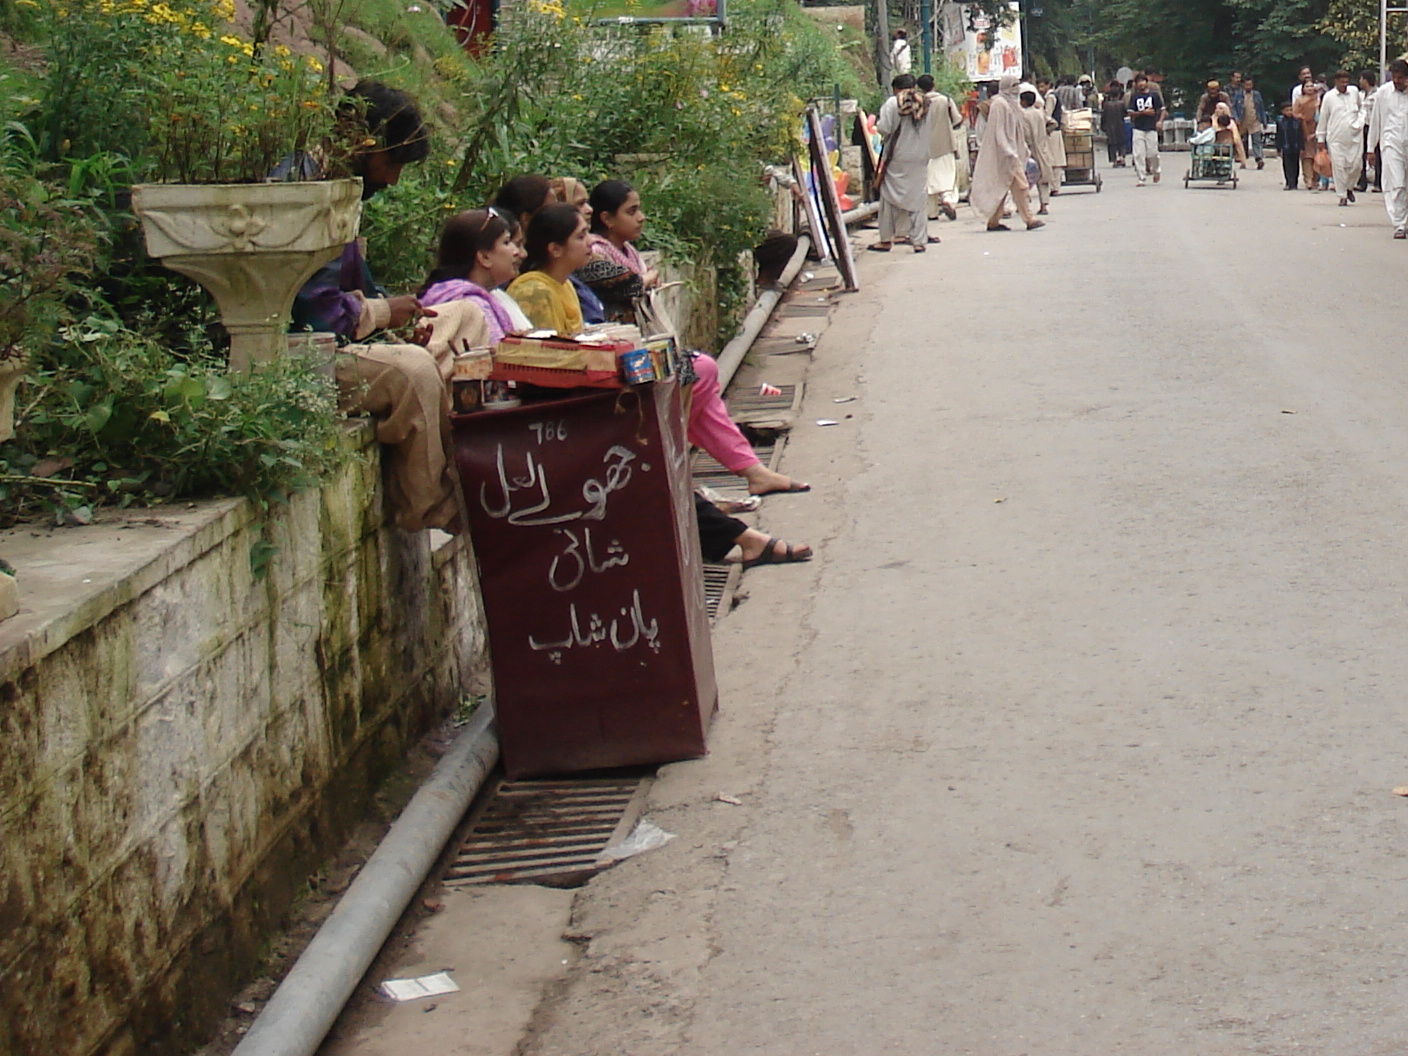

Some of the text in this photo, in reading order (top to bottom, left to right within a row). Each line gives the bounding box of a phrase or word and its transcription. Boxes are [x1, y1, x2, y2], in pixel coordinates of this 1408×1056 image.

[1136, 96, 1153, 111] 84
[529, 589, 661, 665] پان شاپ
